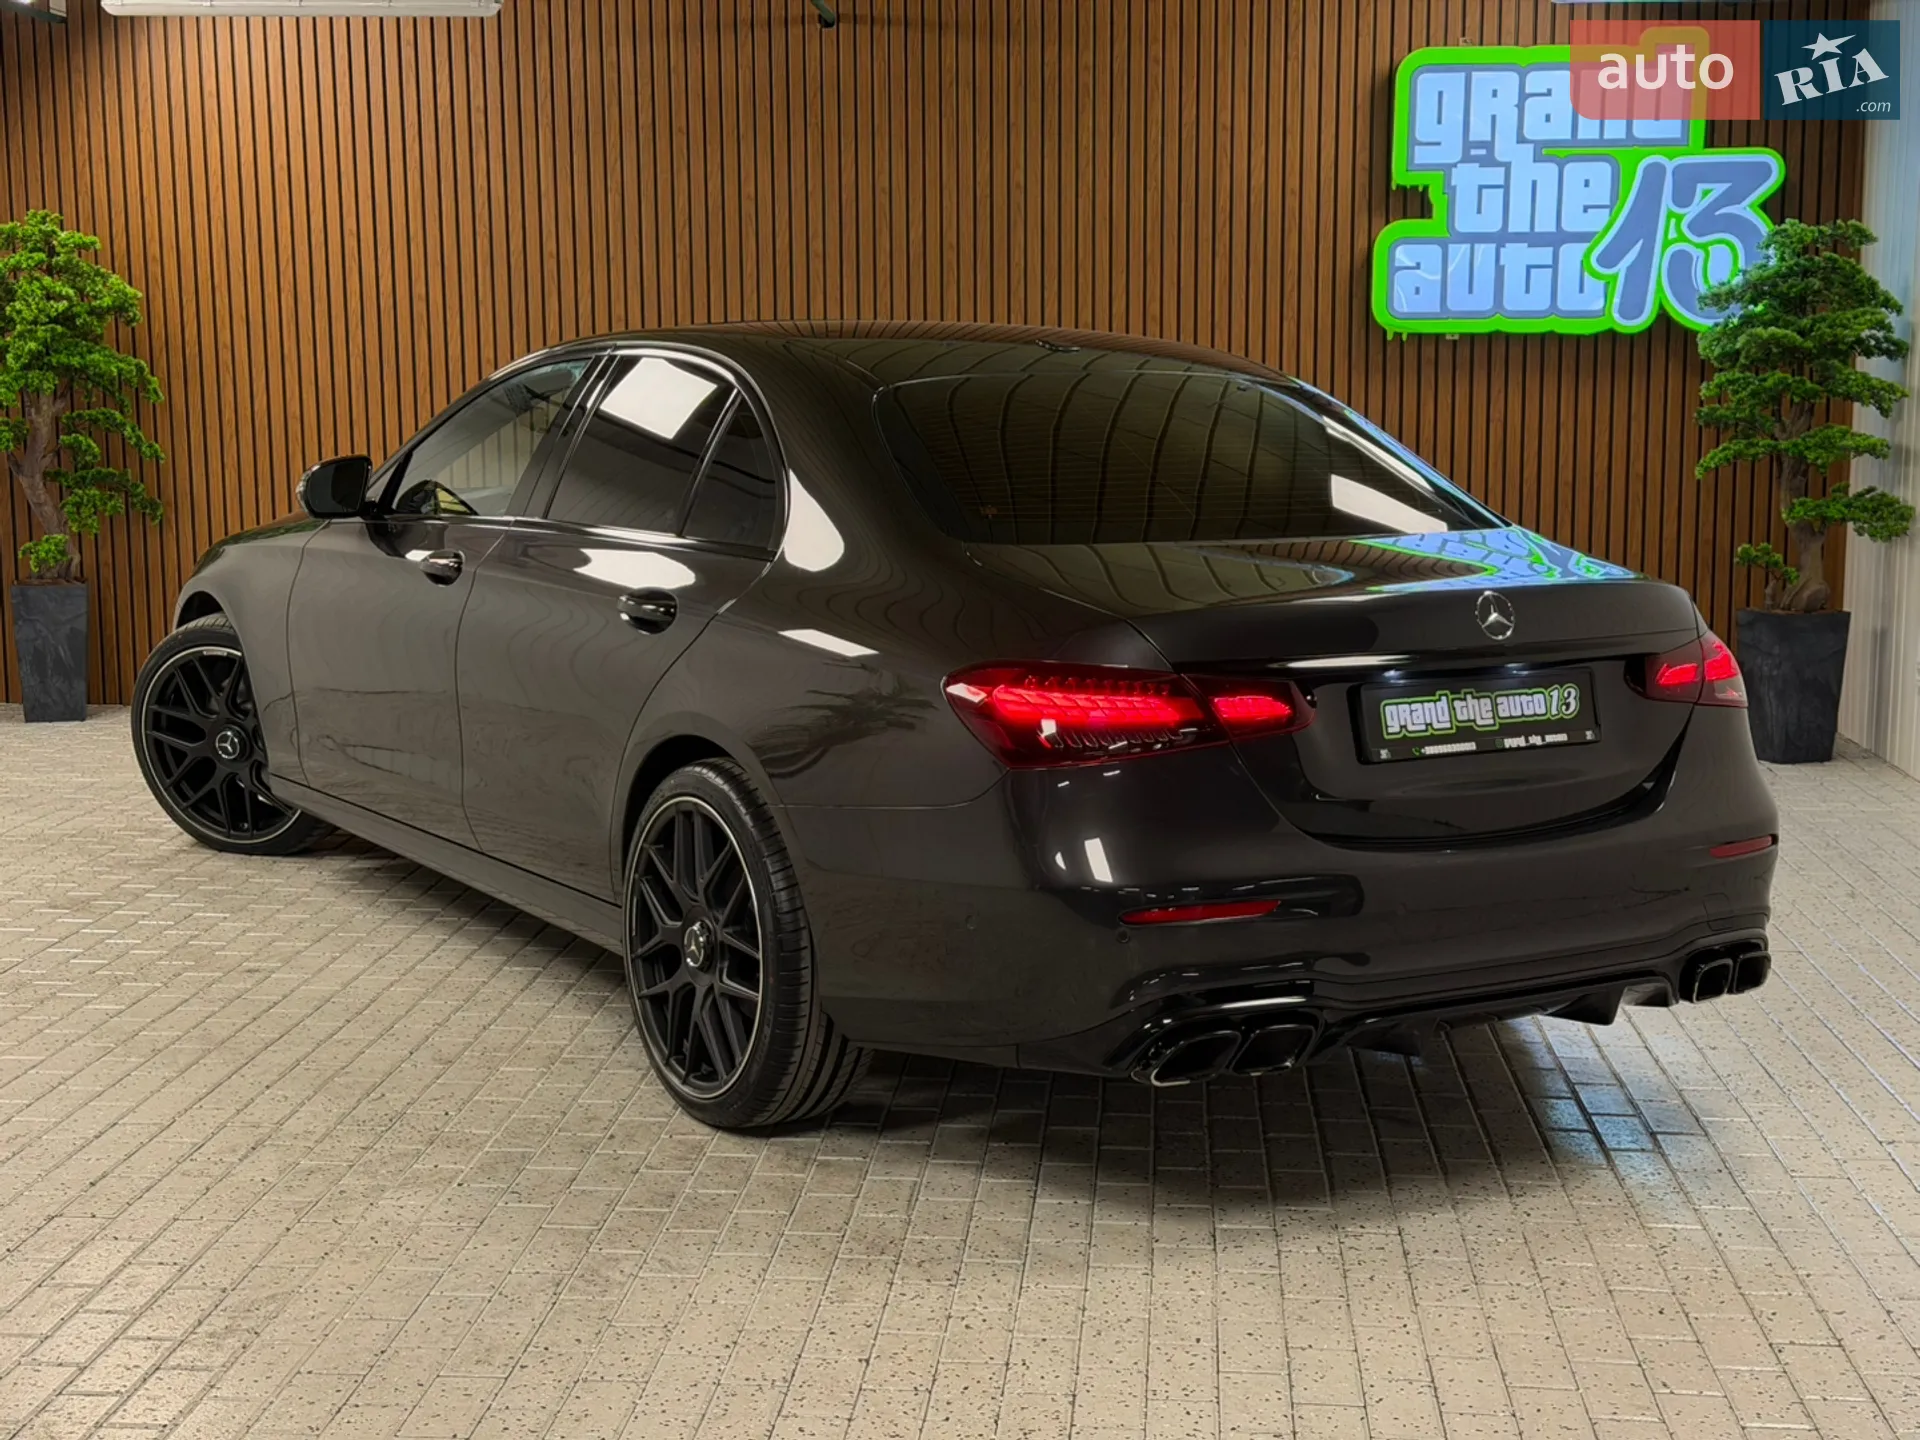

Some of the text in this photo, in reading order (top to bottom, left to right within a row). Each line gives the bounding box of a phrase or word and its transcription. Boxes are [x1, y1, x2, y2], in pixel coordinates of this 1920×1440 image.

[1451, 143, 1613, 233] the
[1393, 242, 1606, 313] auto
[1591, 154, 1781, 326] 13
[1384, 695, 1451, 734] grand
[1453, 693, 1495, 726] the
[1496, 692, 1548, 719] auto
